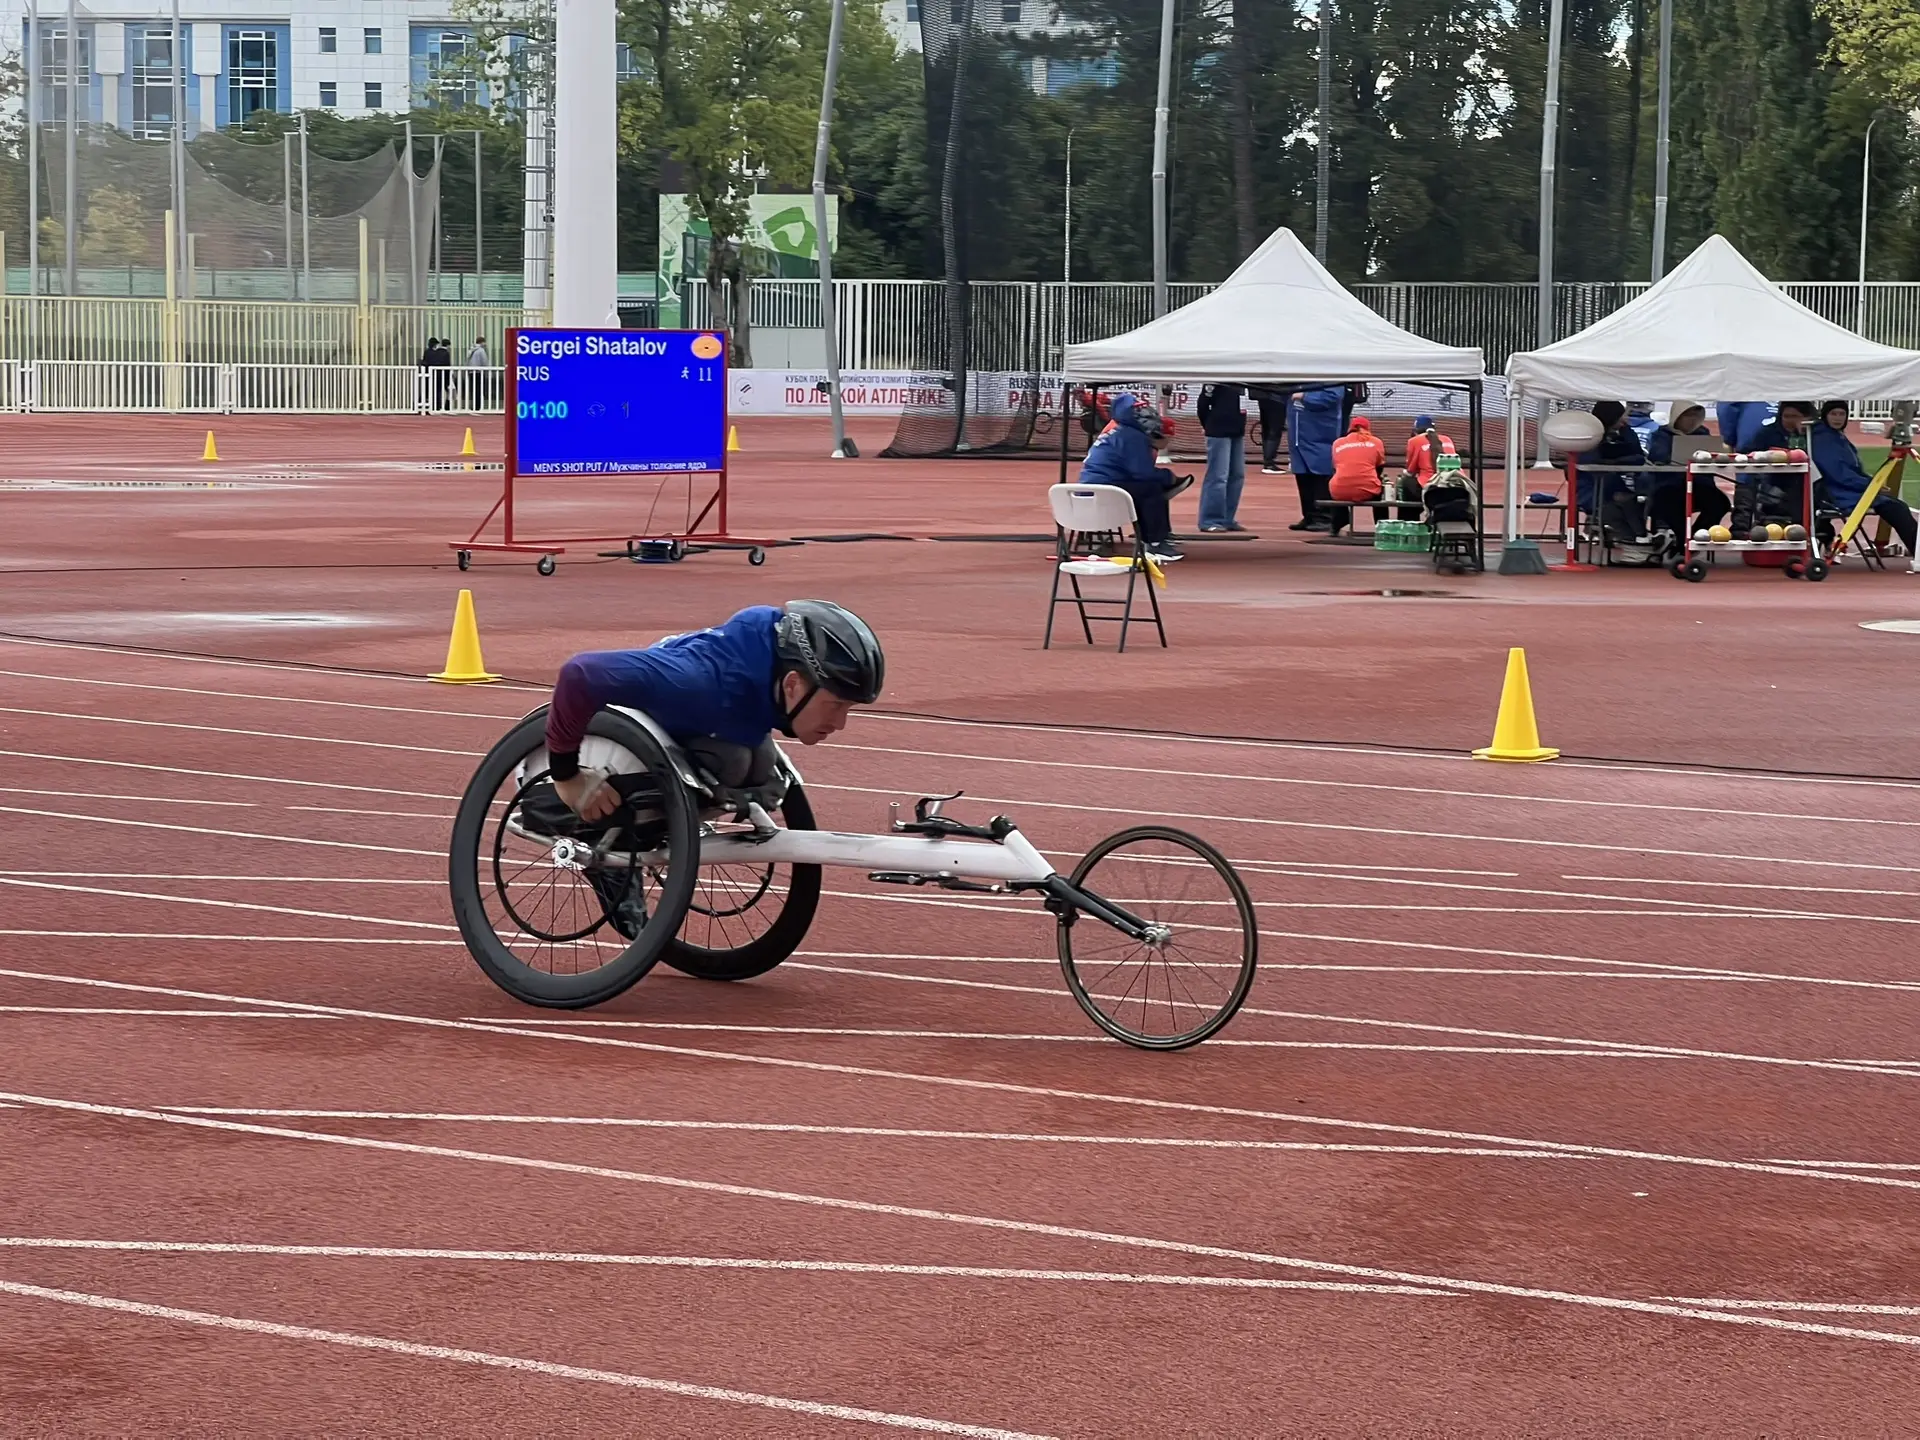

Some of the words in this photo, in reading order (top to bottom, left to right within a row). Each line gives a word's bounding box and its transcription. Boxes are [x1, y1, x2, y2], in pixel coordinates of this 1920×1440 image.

[516, 335, 580, 359] Sergei
[585, 336, 668, 355] Shatalov
[516, 366, 551, 381] RUS
[785, 375, 808, 383] КУБОК
[785, 388, 804, 403] ПО
[809, 385, 866, 403] ЛЕКОЙ
[870, 388, 947, 404] АТЛЕТИКЕ
[516, 401, 569, 419] 01:00
[533, 463, 560, 473] MEN'S
[561, 463, 585, 472] SHOT
[586, 463, 602, 472] PUT
[610, 462, 649, 472] Мужчины
[650, 462, 686, 471] толкание
[687, 461, 707, 471] ядра
